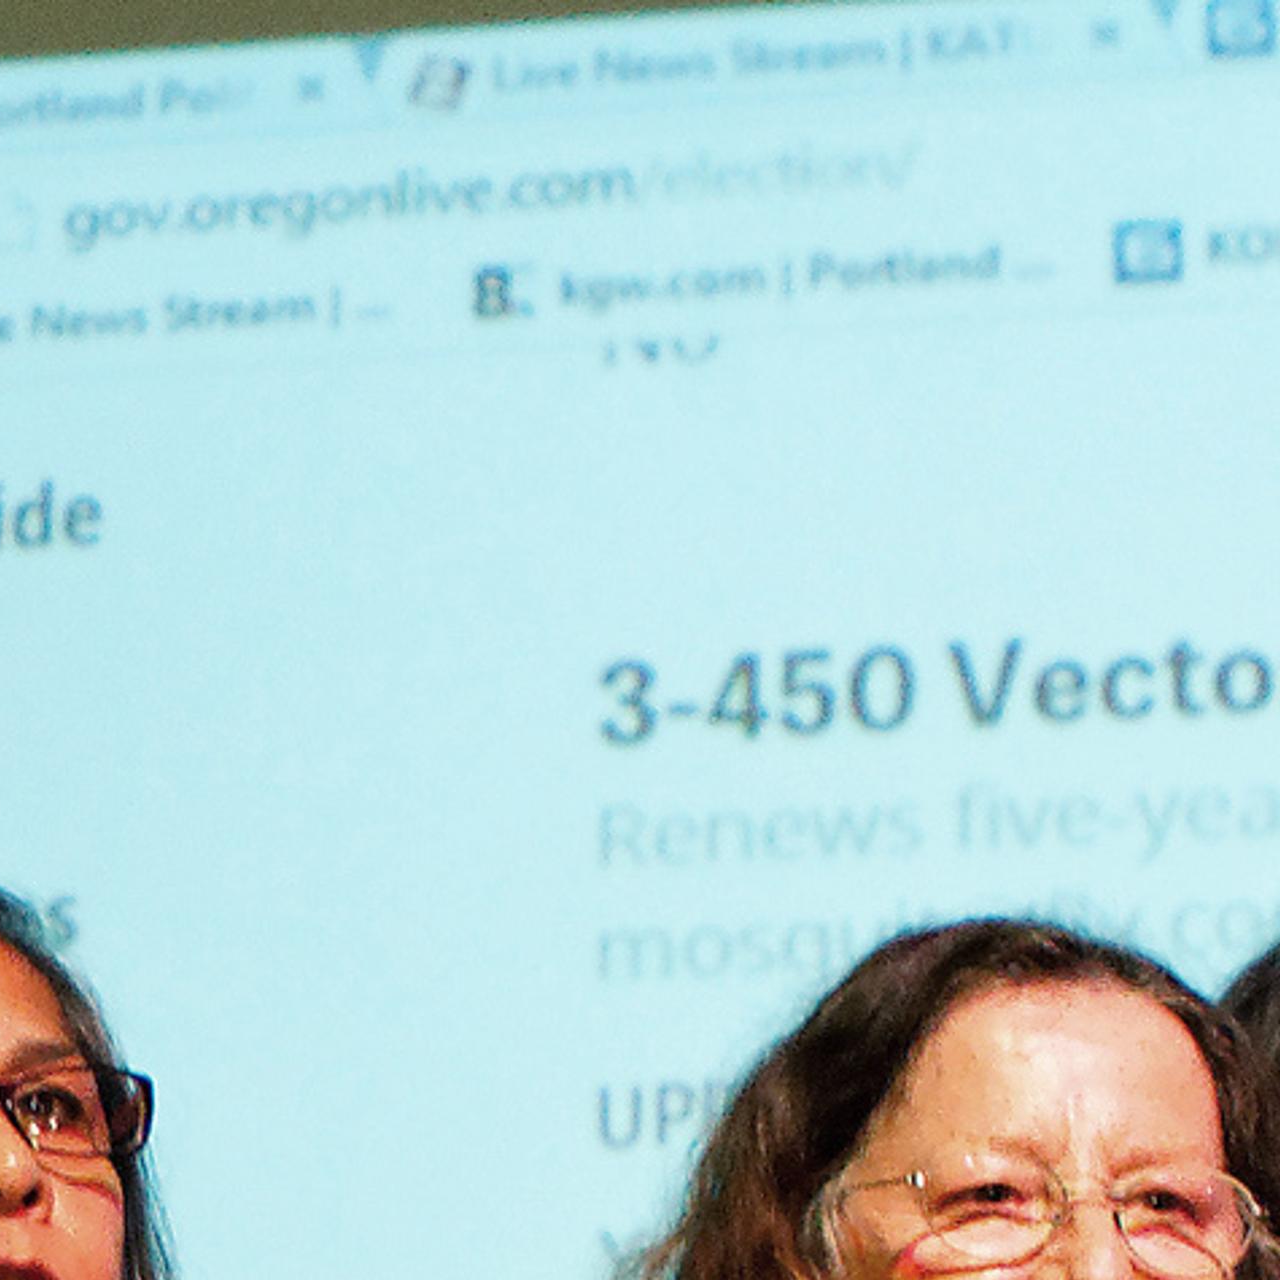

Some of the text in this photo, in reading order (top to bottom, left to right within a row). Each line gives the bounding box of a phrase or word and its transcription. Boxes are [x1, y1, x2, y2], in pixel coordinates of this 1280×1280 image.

[30, 302, 148, 338] News
[165, 290, 316, 334] Stream
[600, 642, 916, 746] 3-450
[598, 796, 924, 868] Renews
